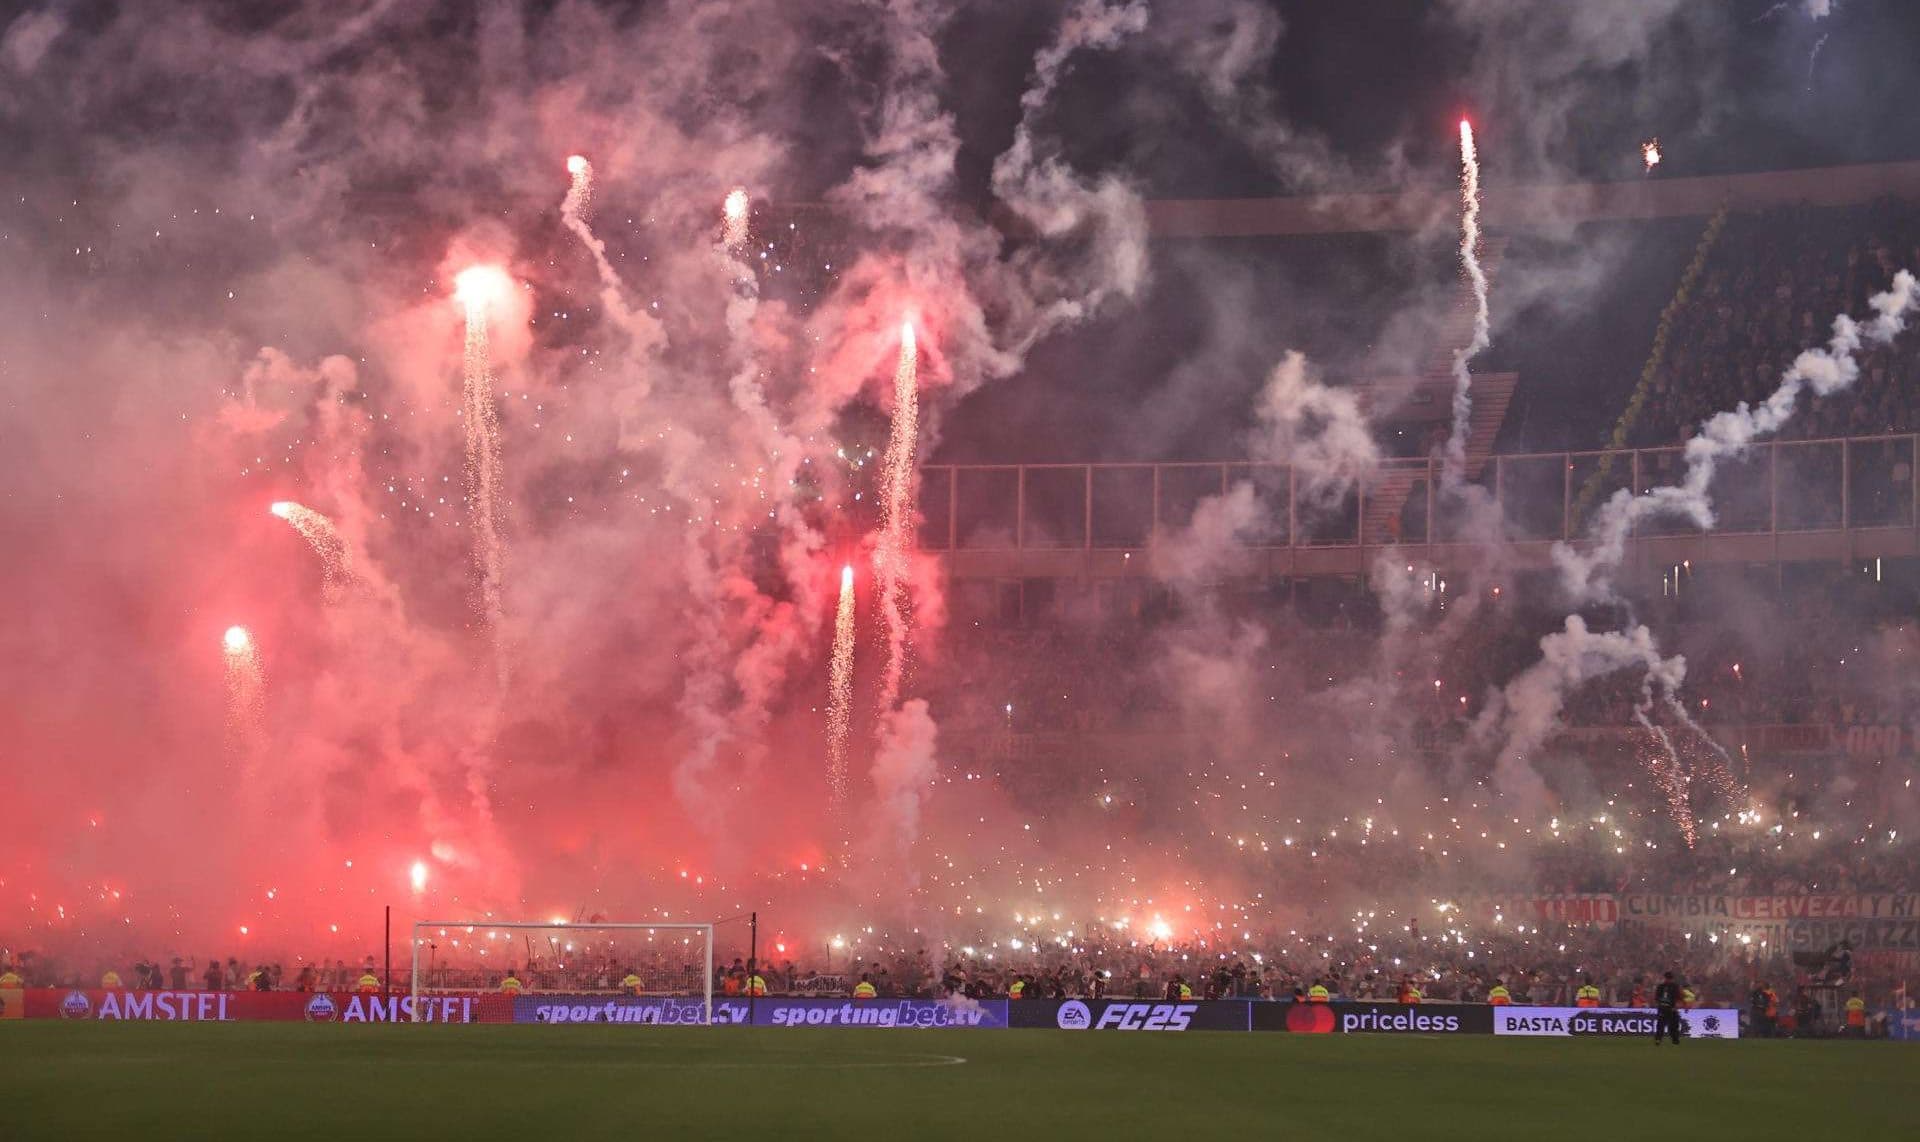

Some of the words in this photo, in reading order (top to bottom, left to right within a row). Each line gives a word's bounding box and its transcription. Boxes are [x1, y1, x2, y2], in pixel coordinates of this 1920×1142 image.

[1628, 896, 1728, 916] CUMBIA
[1735, 895, 1857, 917] CERVEZA
[1871, 896, 1883, 916] Y
[98, 992, 235, 1021] AMSTEL
[771, 1000, 983, 1027] sportingbet.tv
[1064, 1008, 1084, 1019] EA
[1343, 1008, 1459, 1033] priceless
[1506, 1017, 1564, 1032] BASTA
[1574, 1019, 1597, 1033] DE
[1602, 1019, 1682, 1034] RACIS
